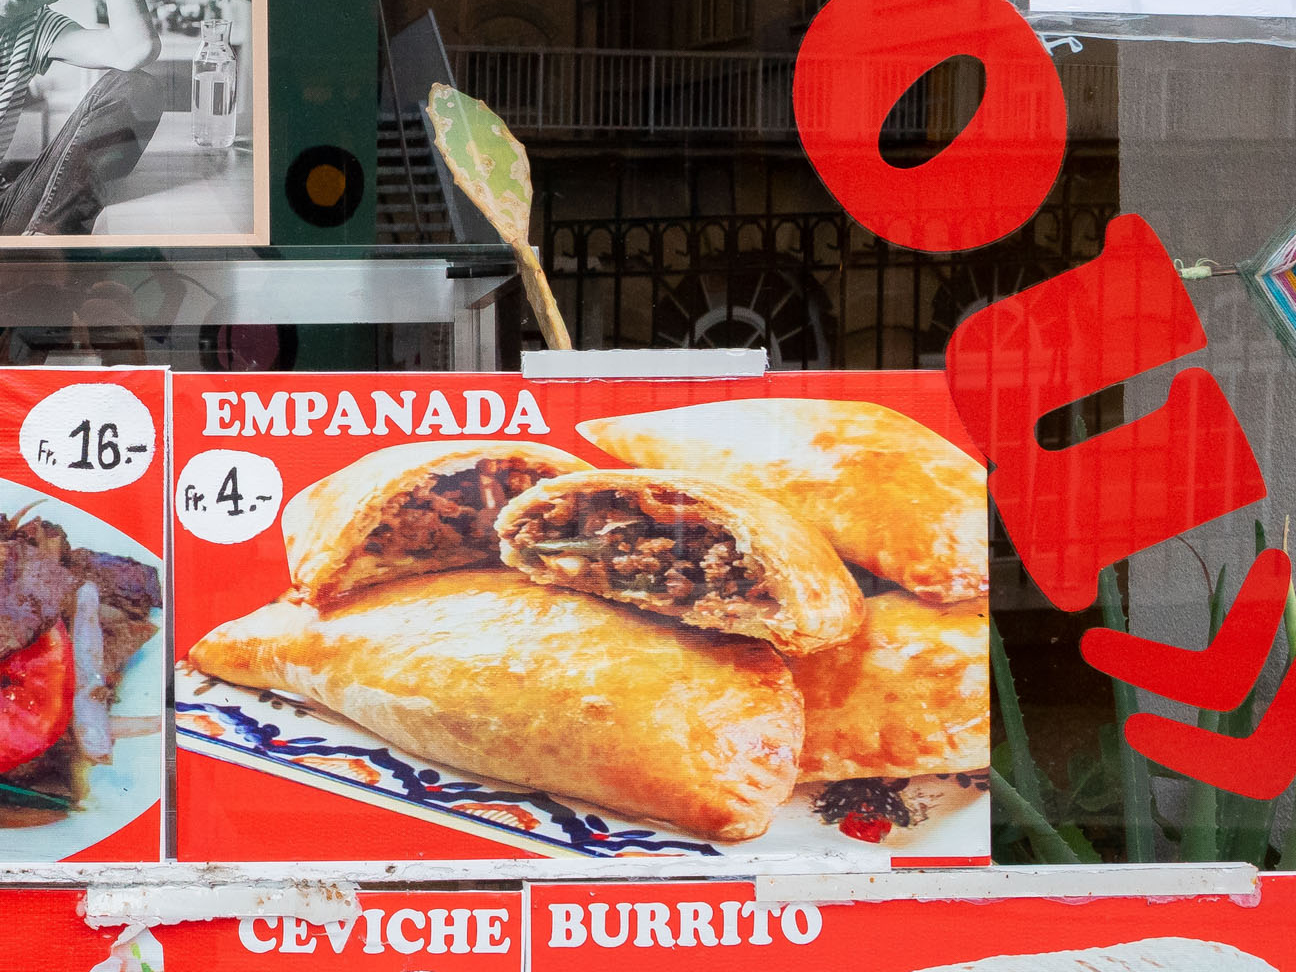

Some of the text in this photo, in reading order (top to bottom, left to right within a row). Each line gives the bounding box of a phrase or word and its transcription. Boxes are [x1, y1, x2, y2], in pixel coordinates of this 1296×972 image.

[202, 389, 550, 436] EMPANADA
[38, 441, 57, 464] Fr.
[184, 487, 207, 512] Fr.
[238, 908, 511, 954] CEVICHE
[548, 900, 822, 948] BURRITO
